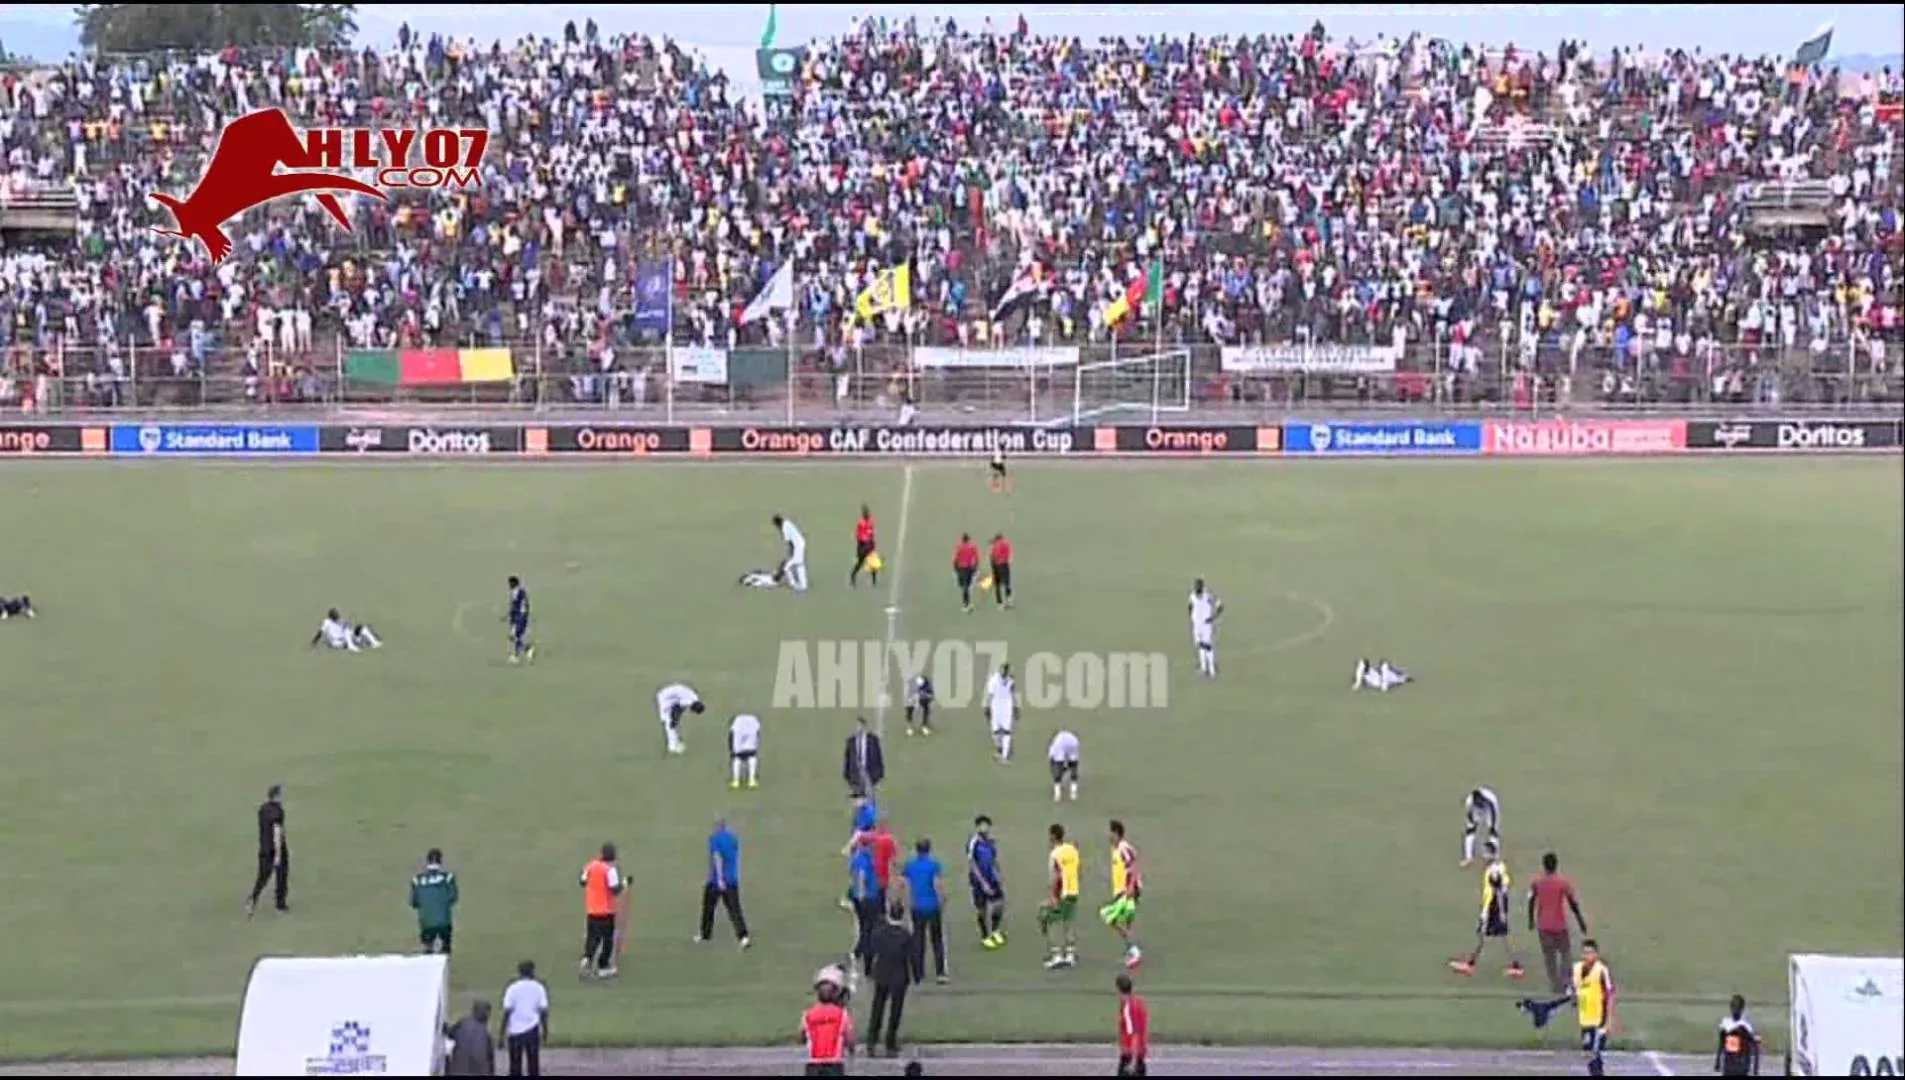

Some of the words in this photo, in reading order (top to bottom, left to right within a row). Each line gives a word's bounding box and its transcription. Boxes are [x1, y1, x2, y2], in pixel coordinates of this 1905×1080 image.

[0, 432, 50, 453] nge
[167, 429, 243, 449] Standard
[248, 429, 291, 449] Bank
[409, 429, 490, 452] Doritos
[577, 429, 660, 454] Orange
[741, 430, 824, 452] Orange
[829, 430, 869, 451] CAF
[877, 429, 1024, 451] Confederation
[1033, 430, 1073, 452] Cup
[1146, 428, 1228, 453] Orange
[1336, 429, 1409, 447] Standard
[1415, 429, 1456, 447] Bank
[1777, 424, 1865, 447] Doritos
